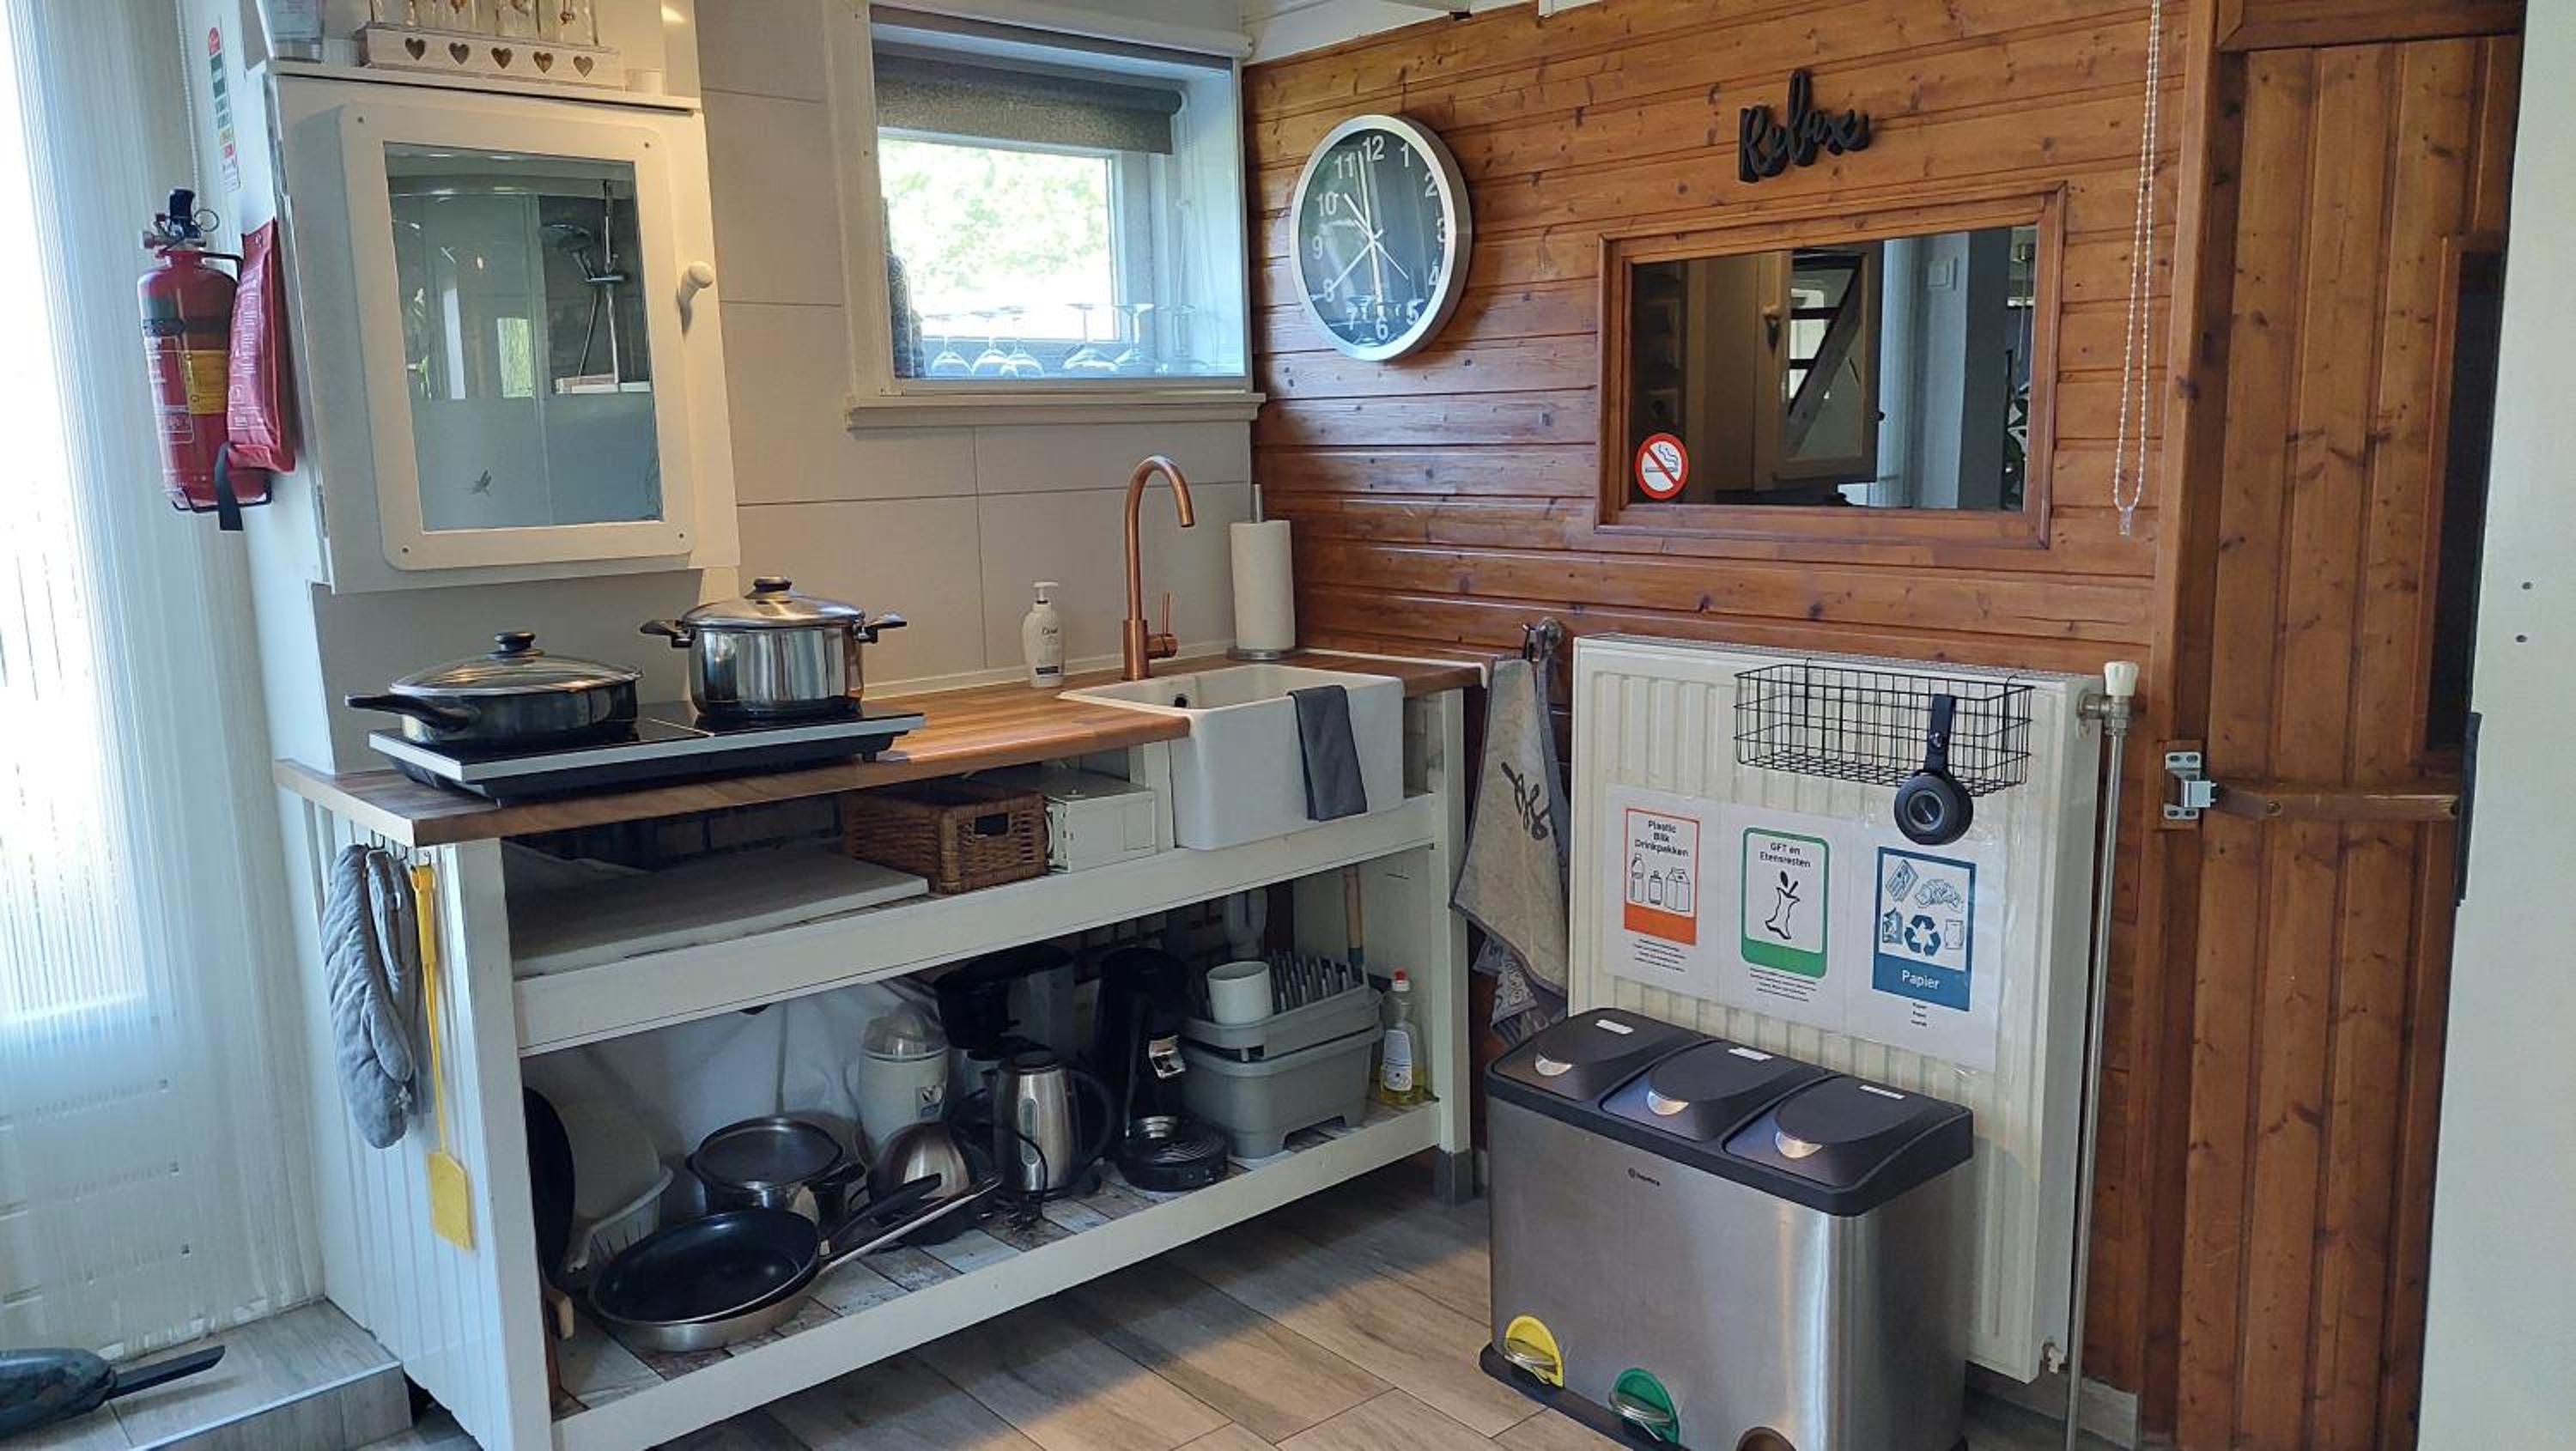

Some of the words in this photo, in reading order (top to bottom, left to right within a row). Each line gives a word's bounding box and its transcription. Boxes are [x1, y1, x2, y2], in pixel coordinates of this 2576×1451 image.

[1363, 135, 1385, 162] 12
[1400, 143, 1410, 167] 1
[1334, 151, 1356, 179] 11
[1425, 173, 1438, 197] 2
[1315, 191, 1339, 217] 10
[1311, 236, 1323, 260] 9
[1428, 264, 1440, 287] 4
[1322, 278, 1335, 302] 8
[1406, 300, 1420, 325] 5
[1375, 316, 1388, 341] 6
[1648, 820, 1677, 833] Plastic
[1634, 839, 1688, 857] Drinkpakken
[1789, 846, 1801, 855] en
[1902, 969, 1940, 990] Papier
